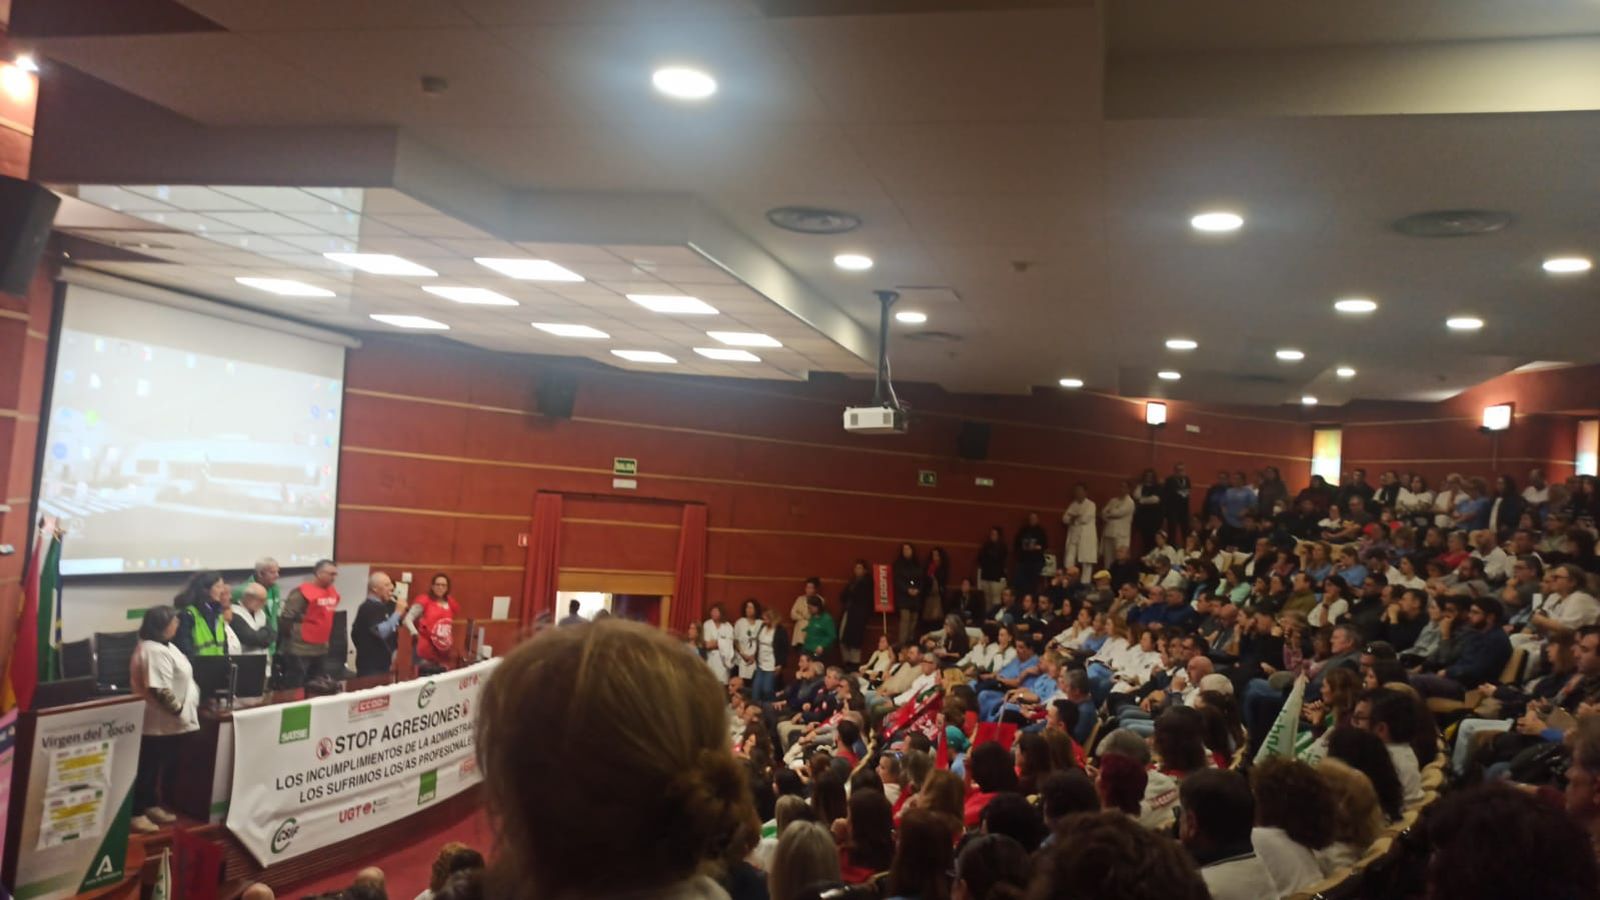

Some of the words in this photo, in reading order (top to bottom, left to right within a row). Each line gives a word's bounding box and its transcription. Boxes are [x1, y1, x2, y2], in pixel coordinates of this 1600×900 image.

[42, 733, 80, 749] Virgen
[83, 726, 102, 741] del
[335, 728, 377, 754] STOP
[381, 703, 460, 742] AGRESIONES
[276, 772, 304, 791] LOS
[306, 745, 403, 783] INCUMPLIMIENTOS
[405, 741, 417, 755] DE
[418, 736, 429, 751] LA
[431, 722, 475, 745] ADMINISTRA
[300, 785, 324, 803] LOS
[327, 769, 381, 796] SUFRIMOS
[384, 756, 417, 778] LOS/AS
[419, 736, 475, 765] PROFESIONALE
[339, 804, 362, 824] UGT
